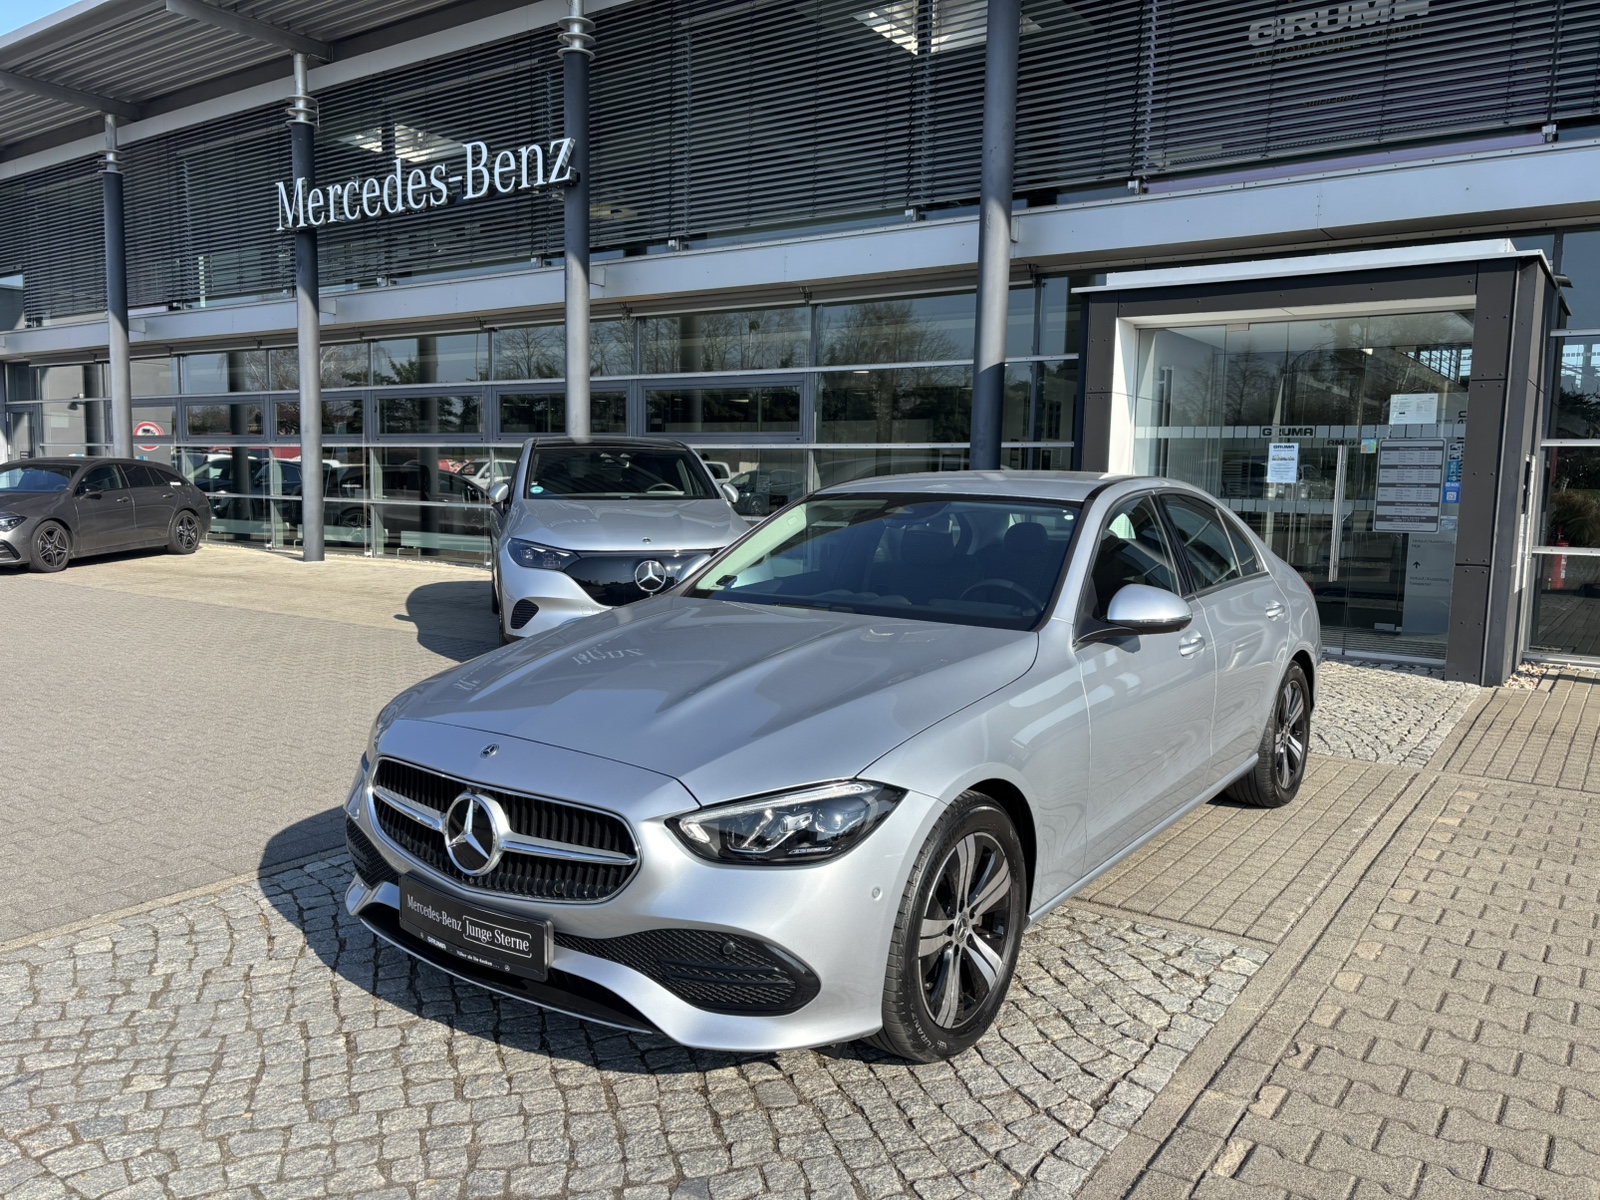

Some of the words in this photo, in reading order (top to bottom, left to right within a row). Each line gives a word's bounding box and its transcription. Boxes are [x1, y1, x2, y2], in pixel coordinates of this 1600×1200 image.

[275, 137, 575, 231] Mercedes-Benz
[1262, 428, 1313, 436] GUMA
[407, 894, 462, 931] Mercedes-Benz
[465, 920, 492, 943] Junge
[494, 930, 529, 951] Sterne
